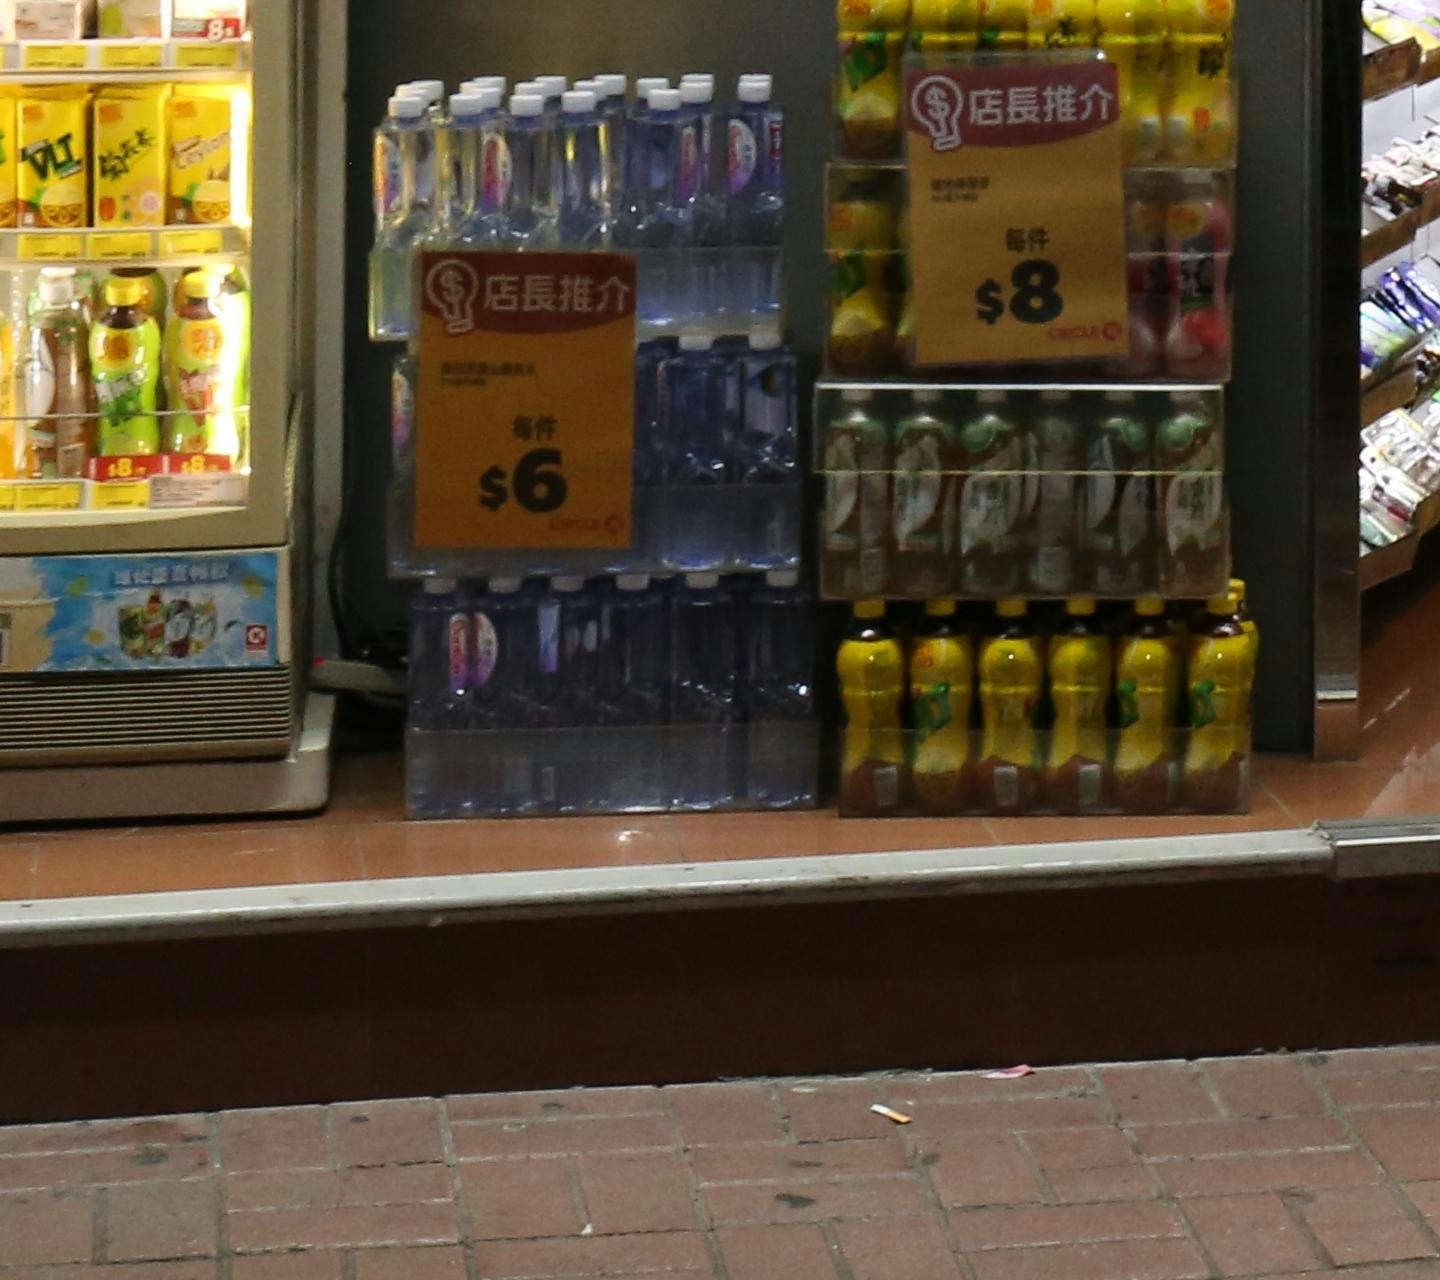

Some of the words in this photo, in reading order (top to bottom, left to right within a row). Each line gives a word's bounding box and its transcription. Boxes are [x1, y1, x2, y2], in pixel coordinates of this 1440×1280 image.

[968, 82, 1114, 127] 店長推介
[1005, 227, 1049, 253] 每件
[483, 273, 632, 314] 店長推介
[975, 259, 1064, 325] $8
[512, 416, 558, 442] 每件
[479, 448, 569, 513] $6
